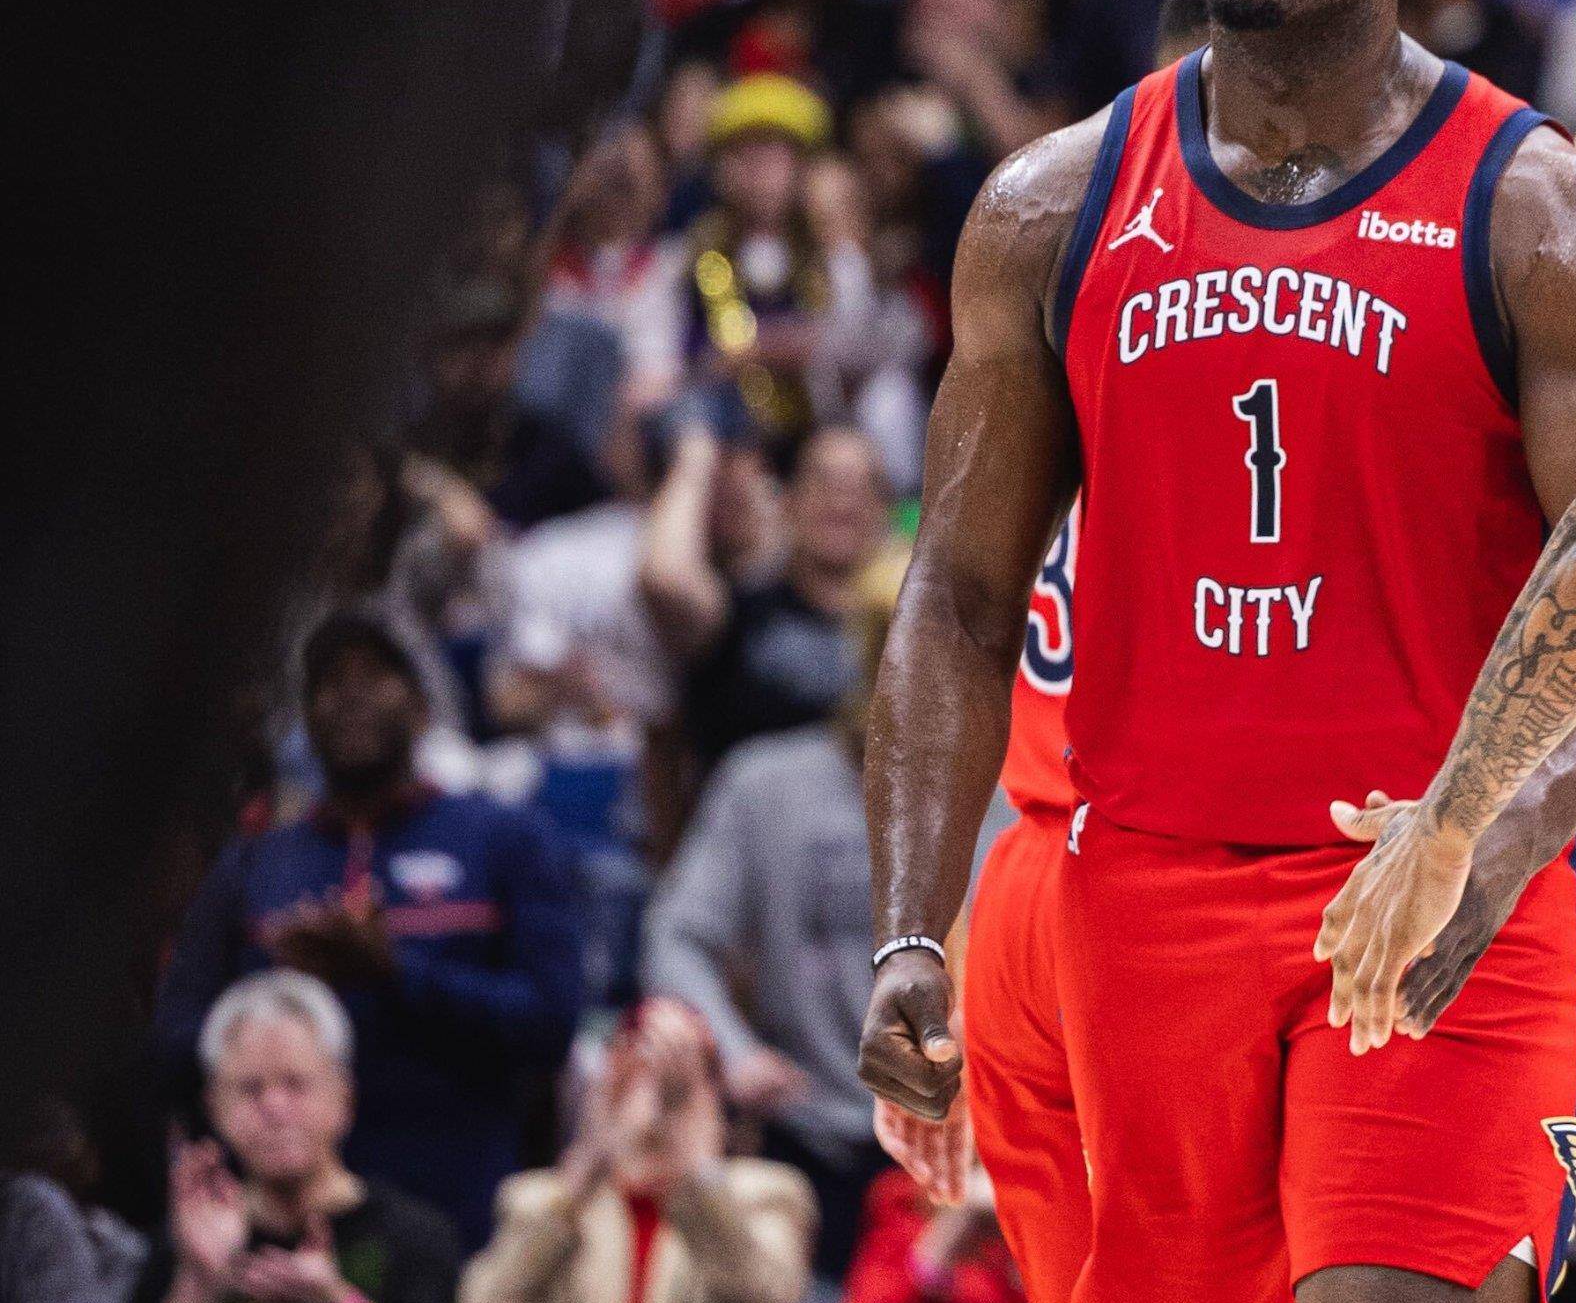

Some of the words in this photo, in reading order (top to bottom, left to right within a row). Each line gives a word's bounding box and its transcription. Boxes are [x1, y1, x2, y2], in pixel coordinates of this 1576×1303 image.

[1358, 209, 1457, 250] ibotta
[1117, 265, 1407, 376] CRESCENT
[1232, 378, 1287, 544] 1
[1194, 575, 1324, 656] CITY
